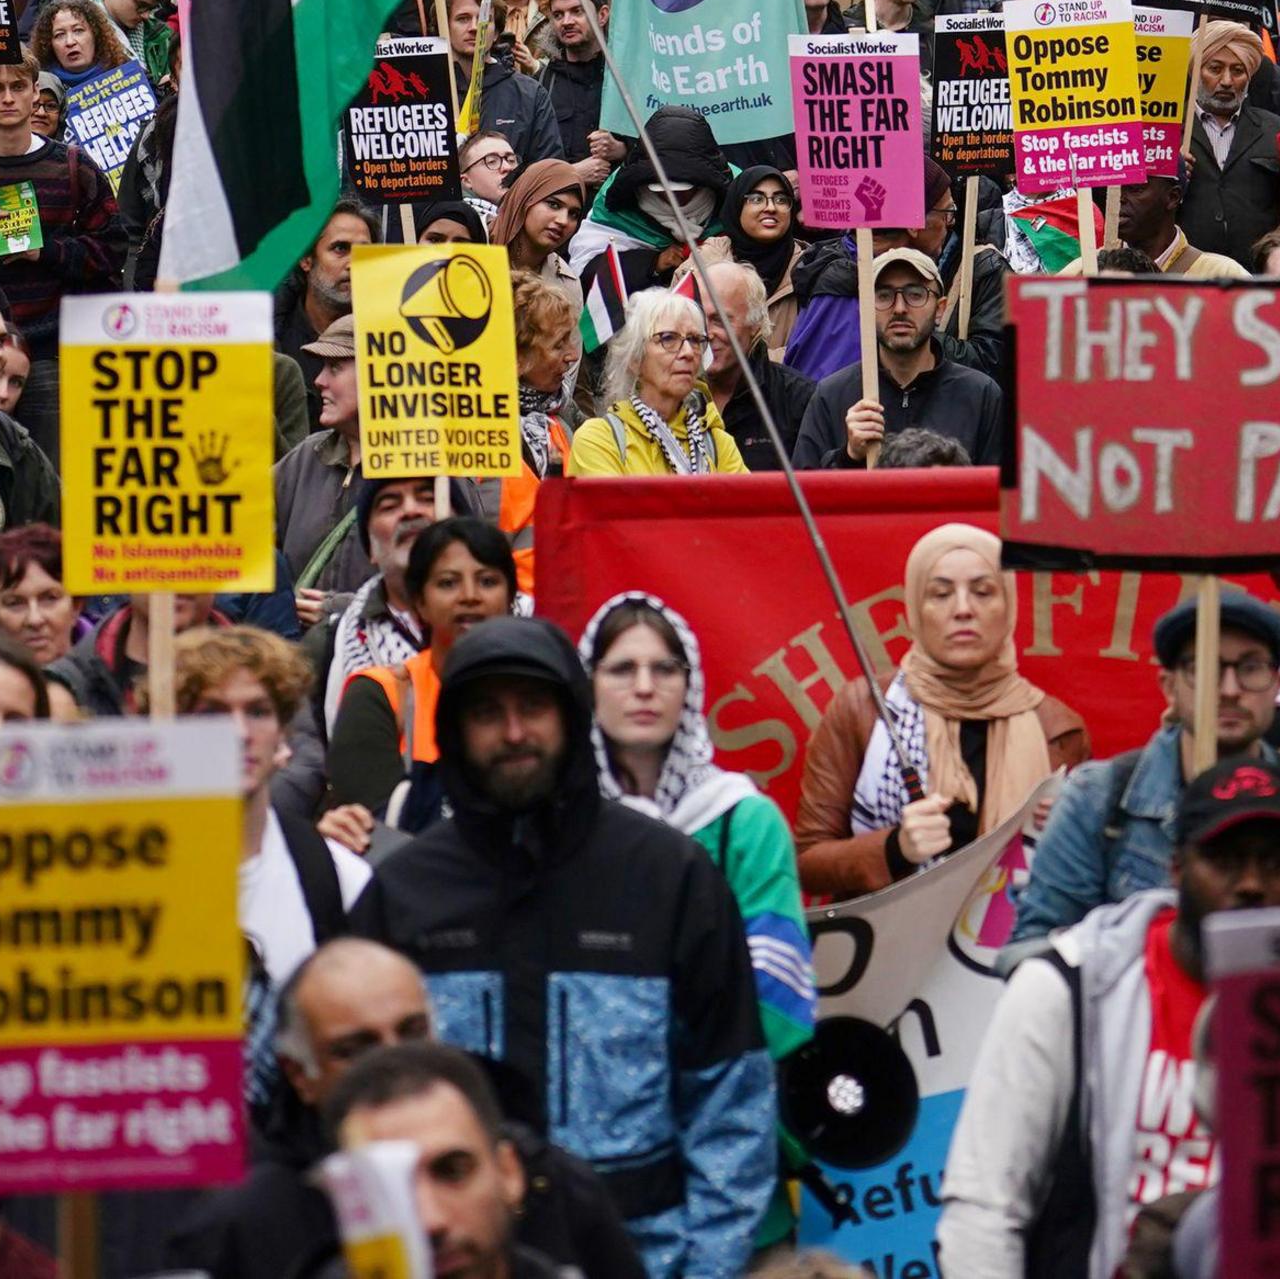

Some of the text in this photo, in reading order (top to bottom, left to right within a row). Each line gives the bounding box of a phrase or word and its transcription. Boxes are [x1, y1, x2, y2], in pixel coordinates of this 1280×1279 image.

[1058, 1, 1102, 14] STAND UP
[1058, 10, 1108, 22] TO RACISM
[732, 11, 761, 45] of
[807, 41, 898, 55] Socialist Worker
[1014, 34, 1109, 65] Oppose
[672, 54, 769, 95] Earth
[802, 61, 894, 97] SMASH
[1015, 67, 1108, 93] Tommy
[71, 84, 156, 144] REFUGEES
[349, 103, 448, 133] REFUGEES
[804, 98, 910, 132] THE FAR
[1018, 96, 1136, 124] Robinson
[351, 131, 450, 160] WELCOME
[807, 135, 885, 169] RIGHT
[1021, 128, 1129, 155] Stop fascists
[1039, 149, 1140, 174] the far right
[811, 174, 849, 187] REFUGEES
[821, 188, 837, 198] AND
[812, 198, 851, 210] MIGRANTS
[814, 210, 851, 222] WELCOME
[366, 331, 406, 357] NO
[1019, 280, 1204, 383] THEY
[92, 350, 218, 391] STOP
[368, 361, 483, 388] LONGER
[92, 398, 184, 440] THE
[370, 392, 511, 420] INVISIBLE
[368, 428, 509, 447] UNITED VOICES
[94, 447, 180, 488] FAR
[370, 451, 511, 470] OF THE WORLD
[1021, 423, 1194, 524] NOT
[95, 494, 242, 537] RIGHT
[121, 543, 243, 560] Islamophobia
[123, 567, 242, 582] antisemitism
[39, 1045, 209, 1099] fascists
[53, 1102, 118, 1150] far
[125, 1096, 234, 1155] right
